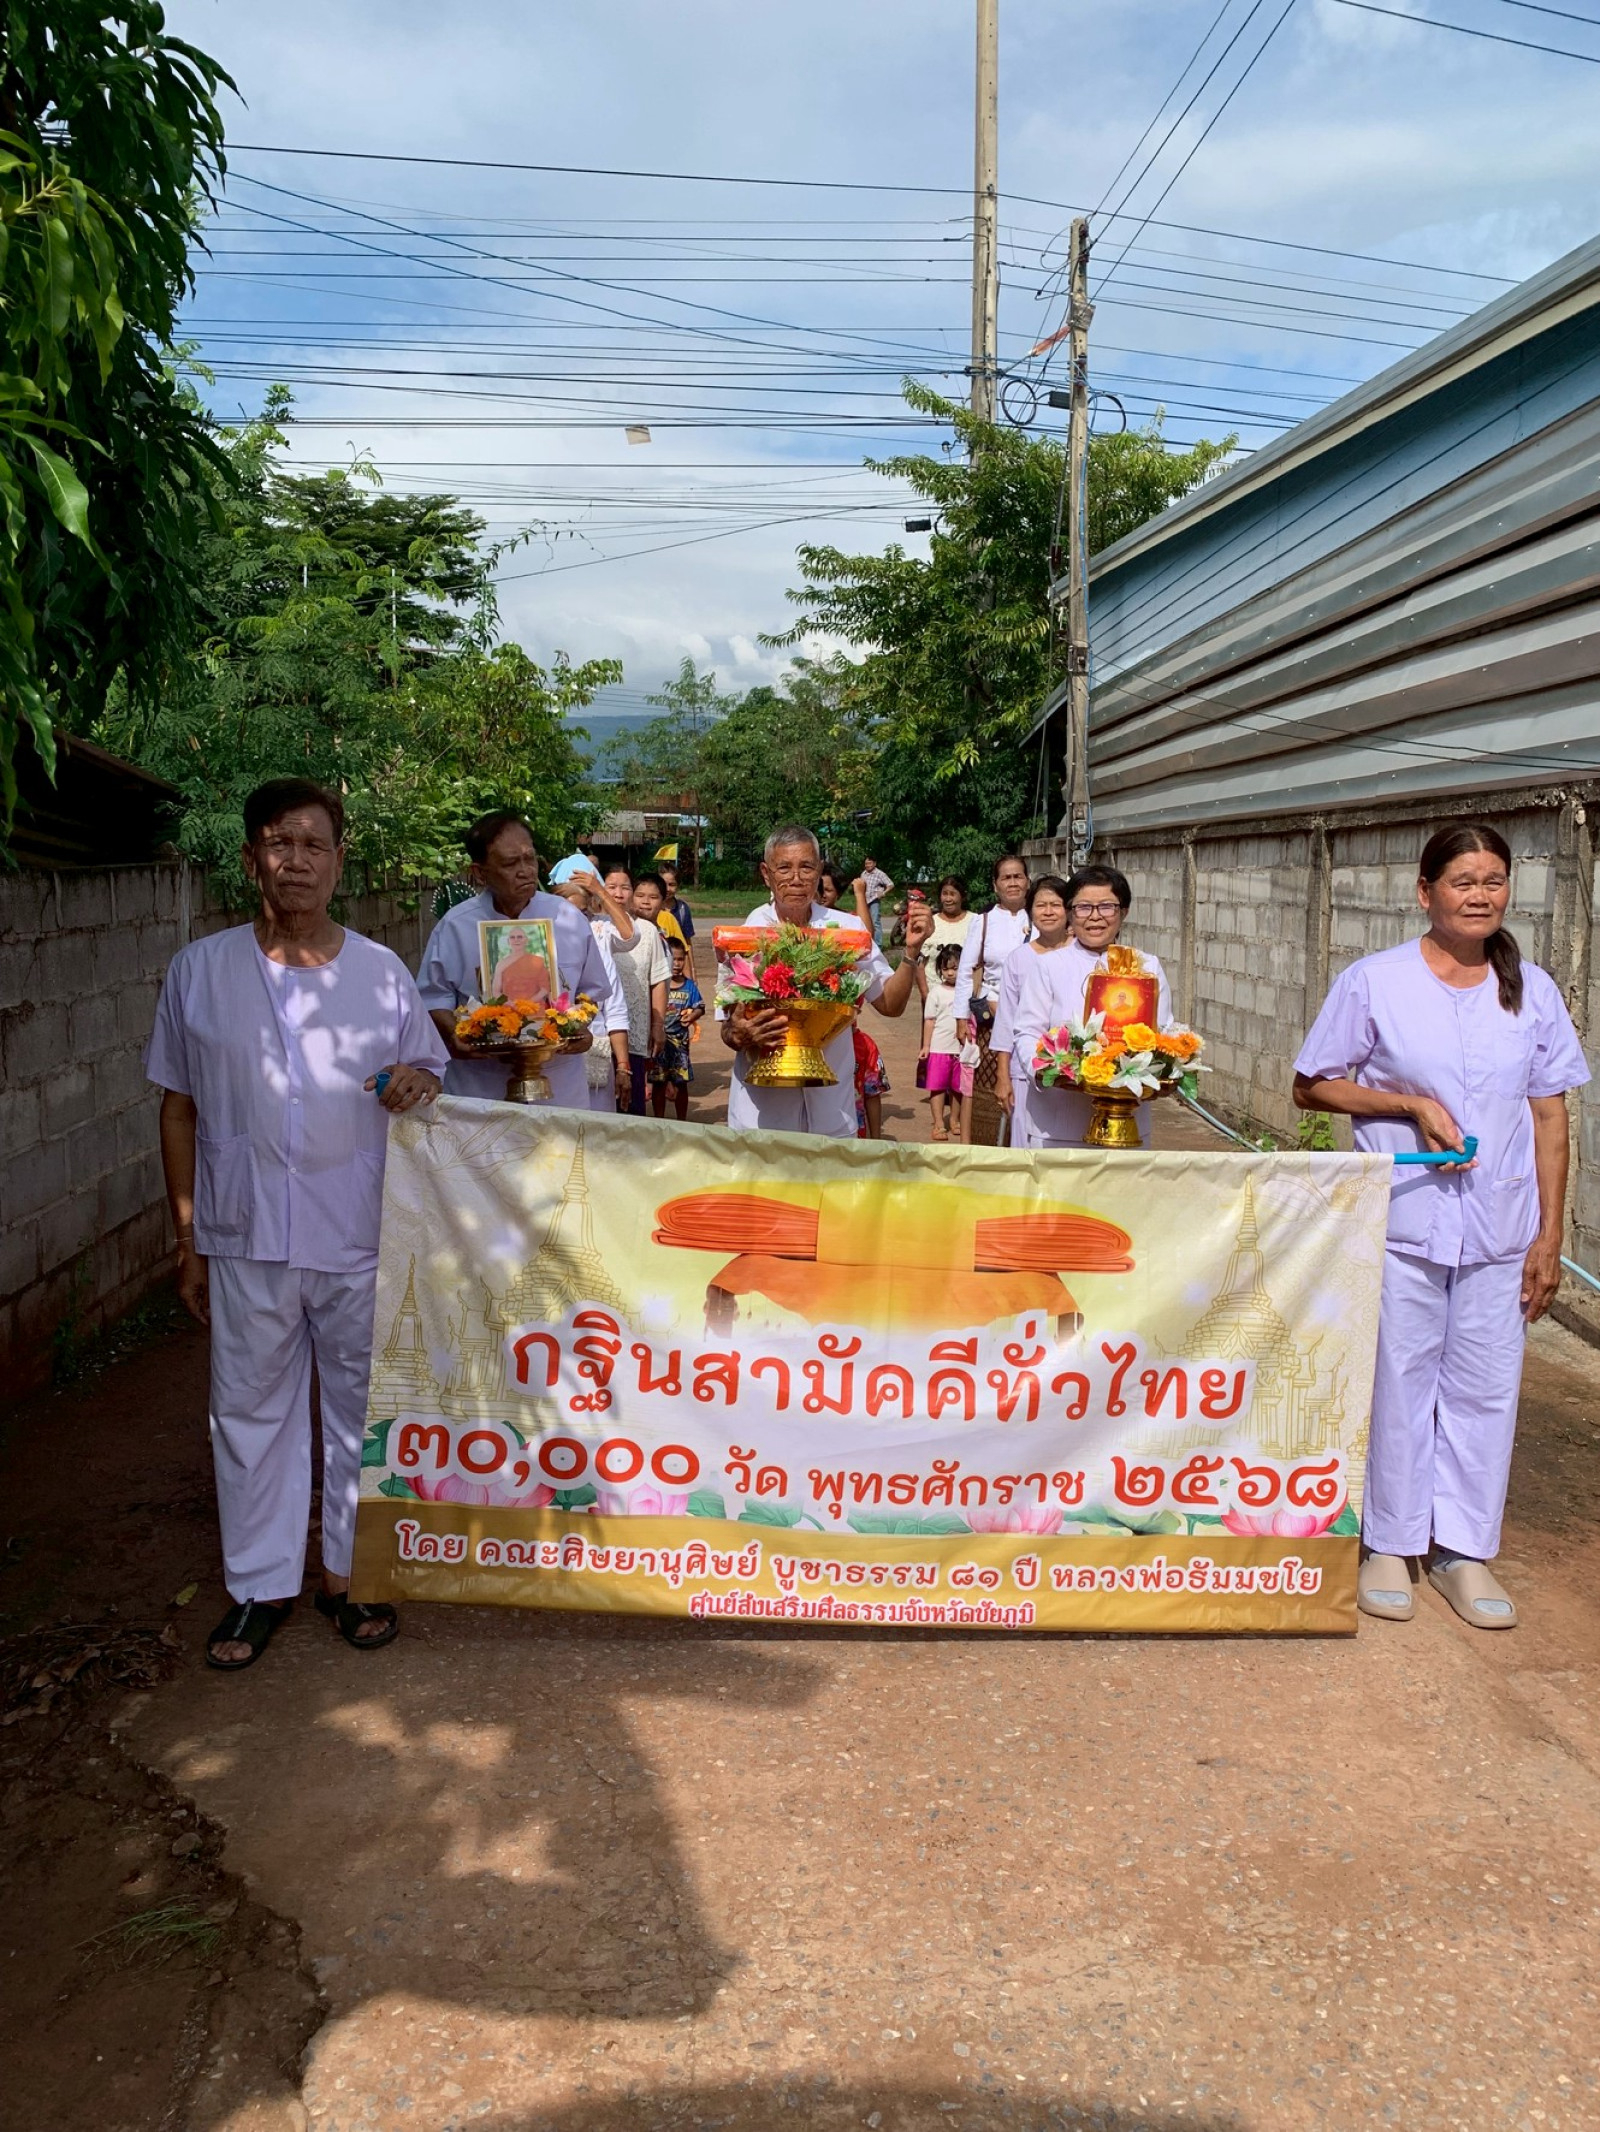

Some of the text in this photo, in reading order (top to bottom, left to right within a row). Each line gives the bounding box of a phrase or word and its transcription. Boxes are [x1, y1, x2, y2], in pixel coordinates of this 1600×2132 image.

[513, 1311, 1246, 1422] กฐินสามัคคีทั่วไทย
[398, 1423, 1340, 1519] ๓๐,๐๐๐ วัด พุทธศักราช ๒๕๖๘
[400, 1524, 1320, 1591] โดย คณะศิษยานุศิษย์ บูชาธรรม ๘๑ ปี หลวงพ่อธัมมชโย
[690, 1591, 1034, 1628] ศูนย์ส่งเสริมศีลธรรมจังหวัดชัยภูมิ
